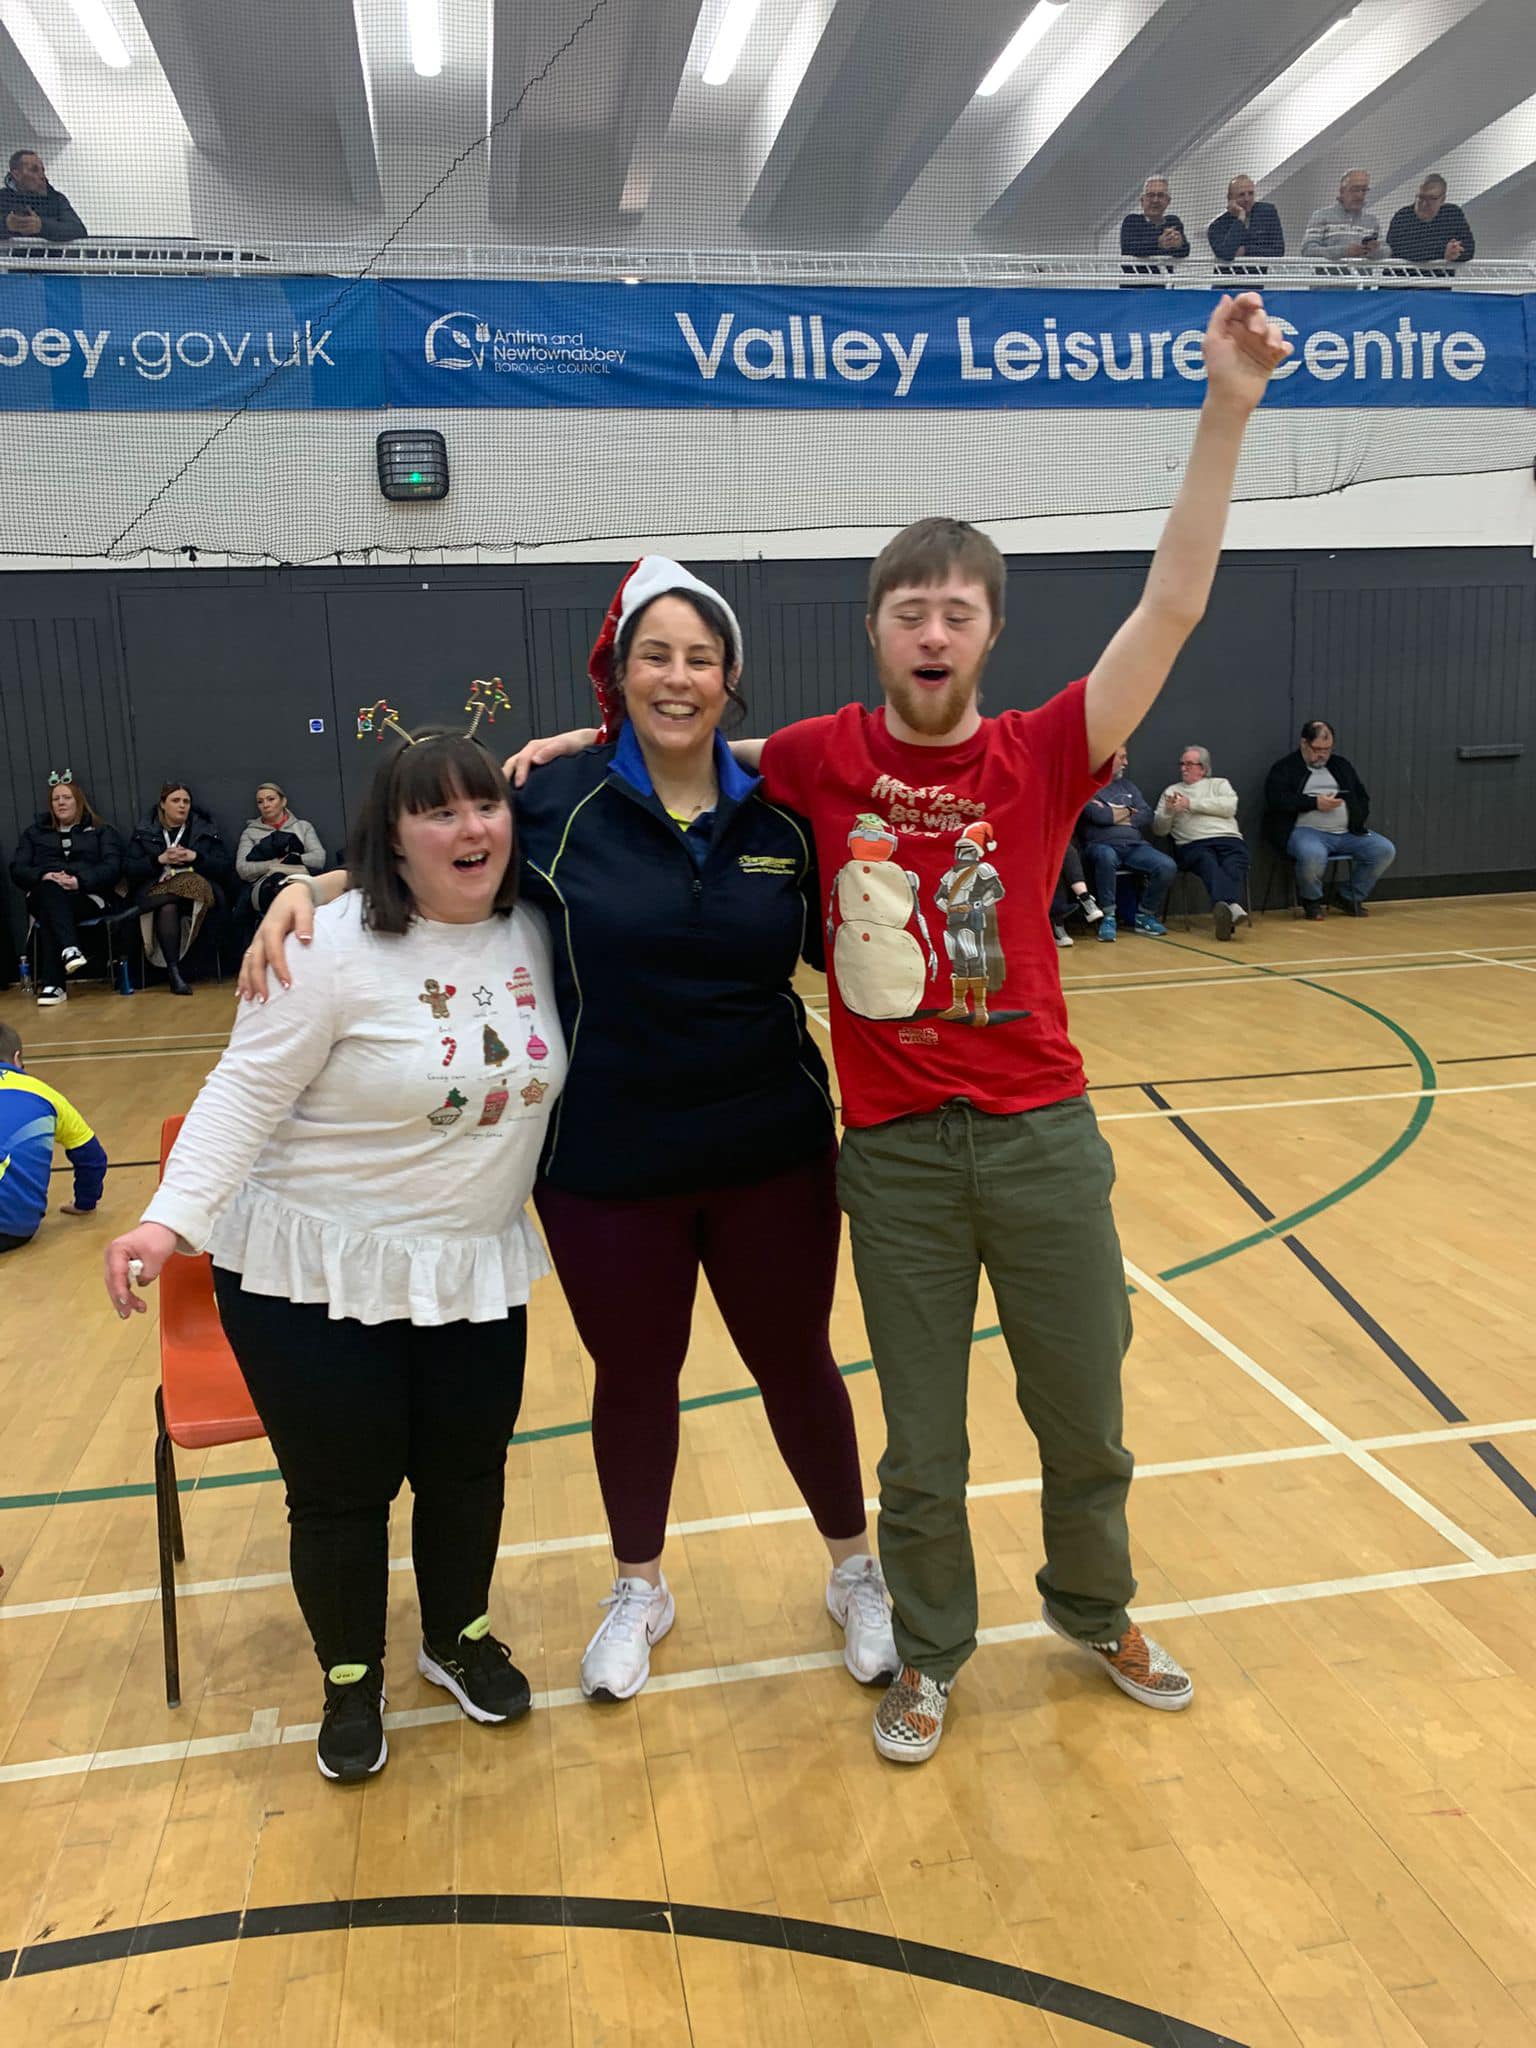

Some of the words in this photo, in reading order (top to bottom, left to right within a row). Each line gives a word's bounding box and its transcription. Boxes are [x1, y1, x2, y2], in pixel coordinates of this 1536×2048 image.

[493, 328, 548, 345] Antrim
[551, 332, 584, 346] and
[493, 345, 627, 365] Newtownabbey
[674, 312, 930, 397] Valley
[957, 316, 1209, 381] Leisure
[494, 362, 554, 373] BOROUGH
[557, 363, 611, 374] COUNCIL
